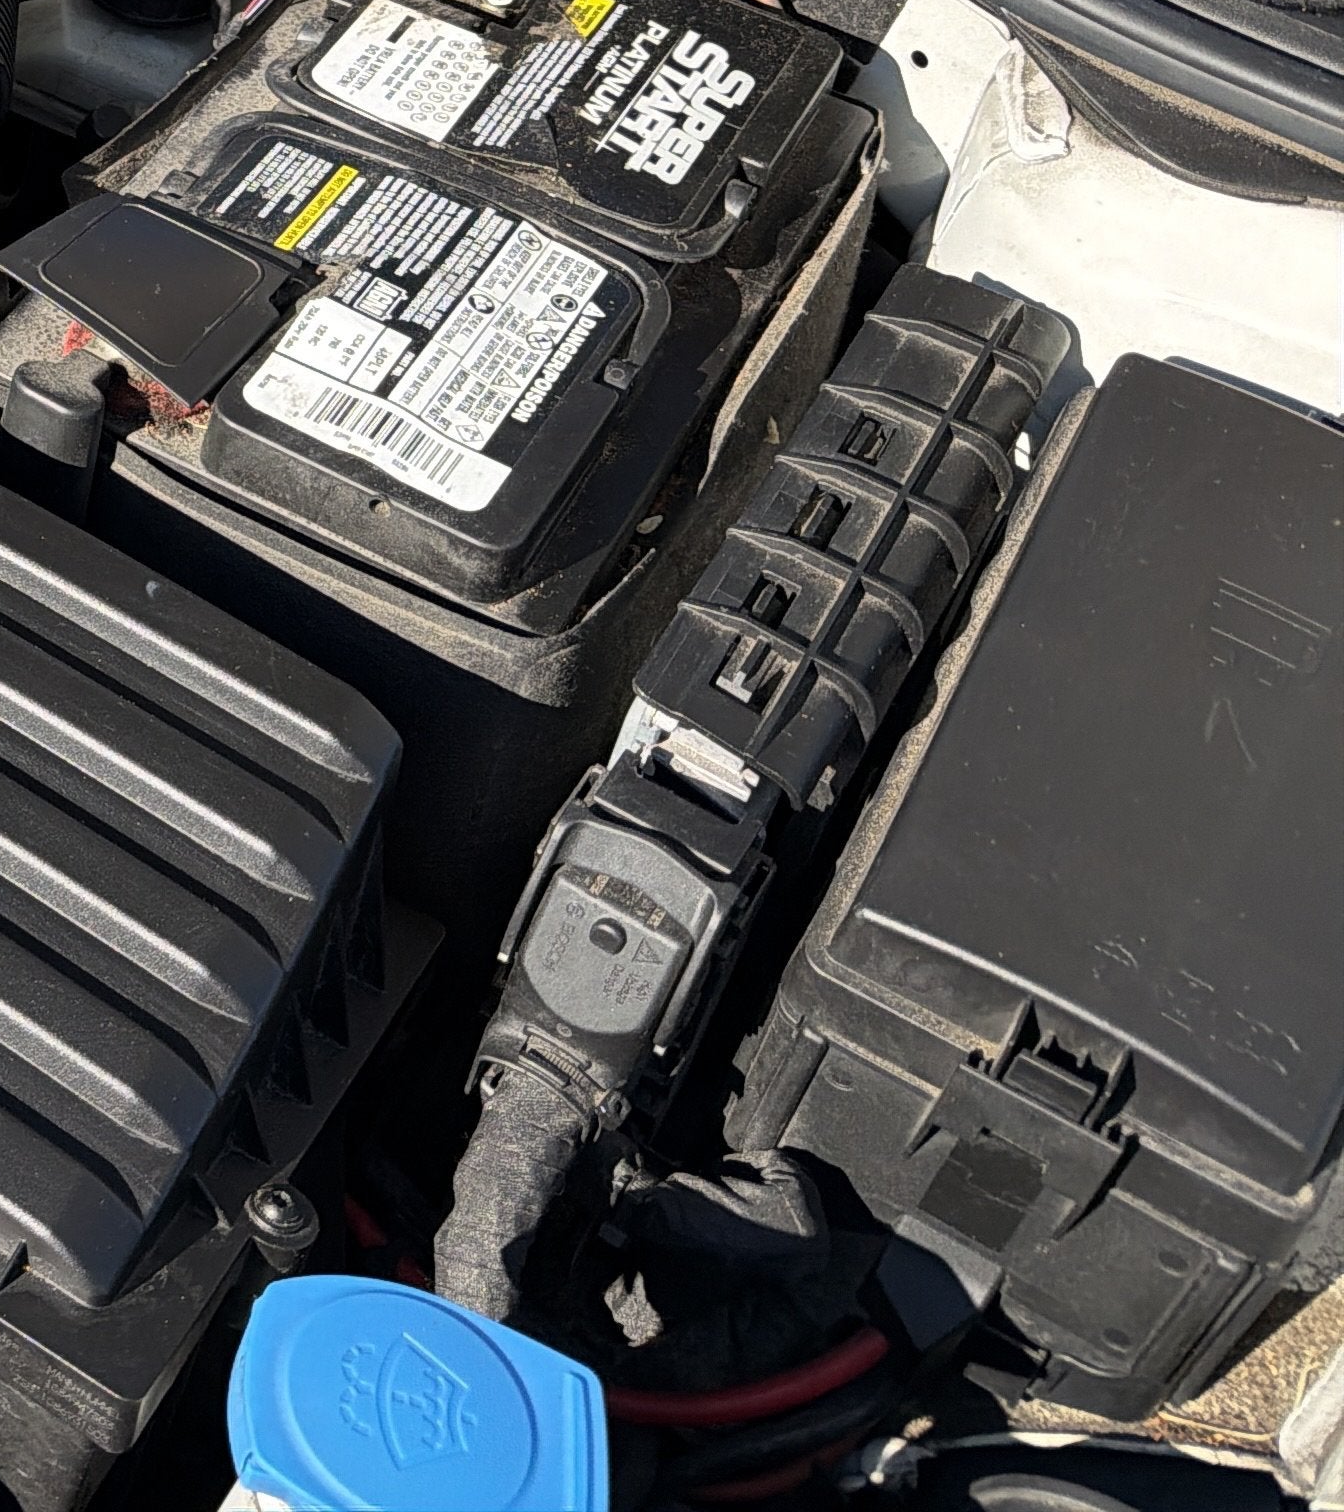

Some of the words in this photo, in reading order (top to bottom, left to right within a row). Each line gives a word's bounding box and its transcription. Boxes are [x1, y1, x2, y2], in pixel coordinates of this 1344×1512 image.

[574, 17, 672, 128] PLATINUM
[591, 45, 623, 74] AGM
[609, 29, 730, 172] START
[642, 68, 756, 186] SUPER
[356, 277, 403, 323] AGM
[511, 310, 599, 423] DANGER/POISON
